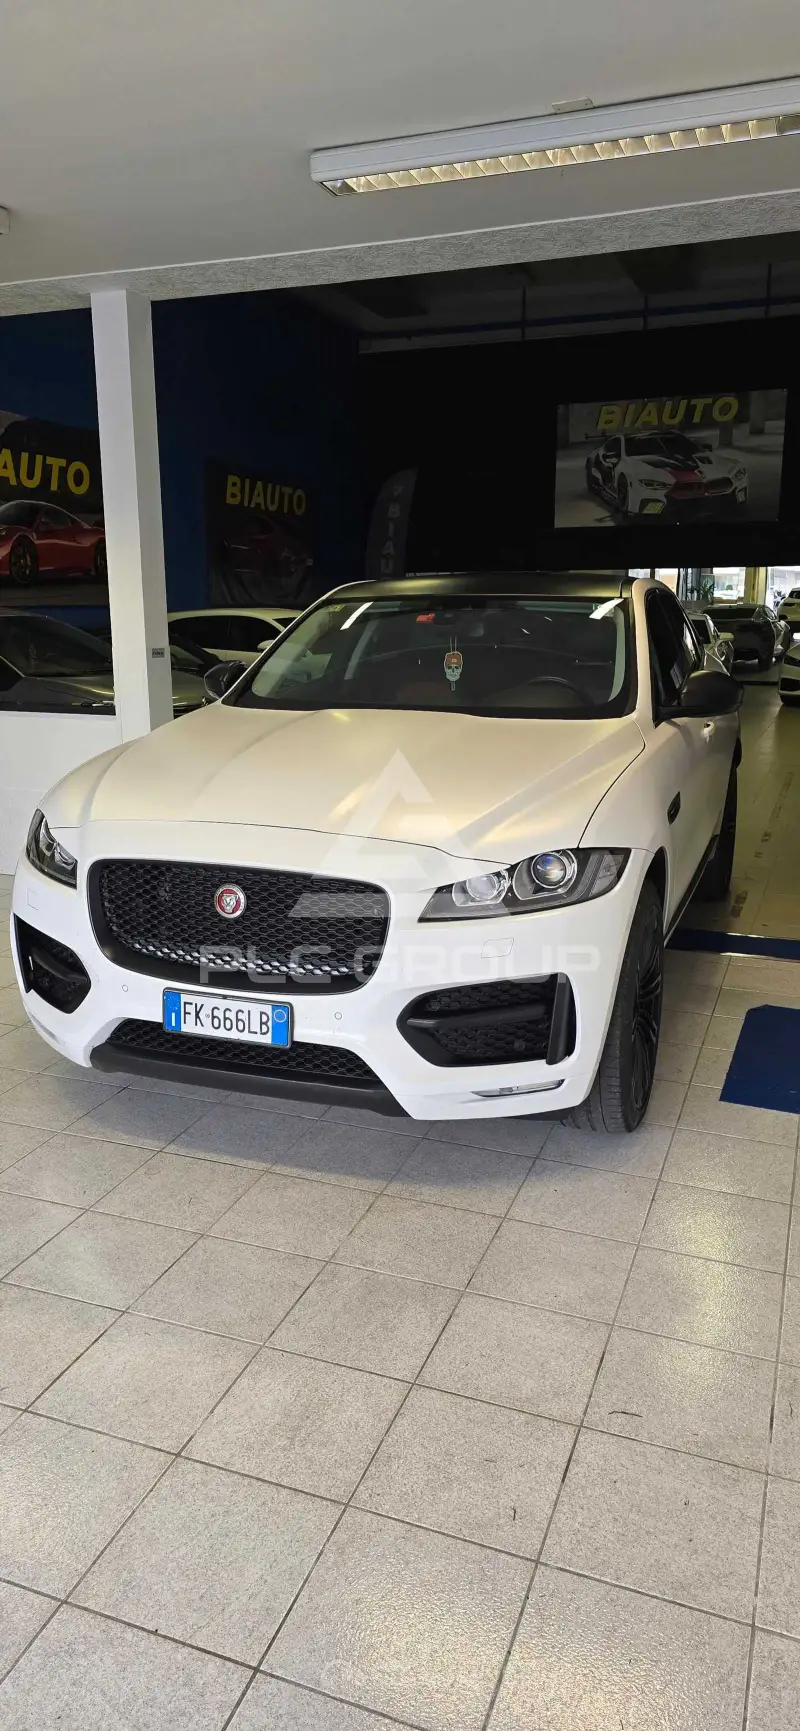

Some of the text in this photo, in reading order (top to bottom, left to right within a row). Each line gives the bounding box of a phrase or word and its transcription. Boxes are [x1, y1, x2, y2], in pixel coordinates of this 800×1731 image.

[596, 395, 740, 430] BIAUTO
[225, 474, 307, 516] BIAUTO
[183, 1001, 270, 1036] FK 666LB
